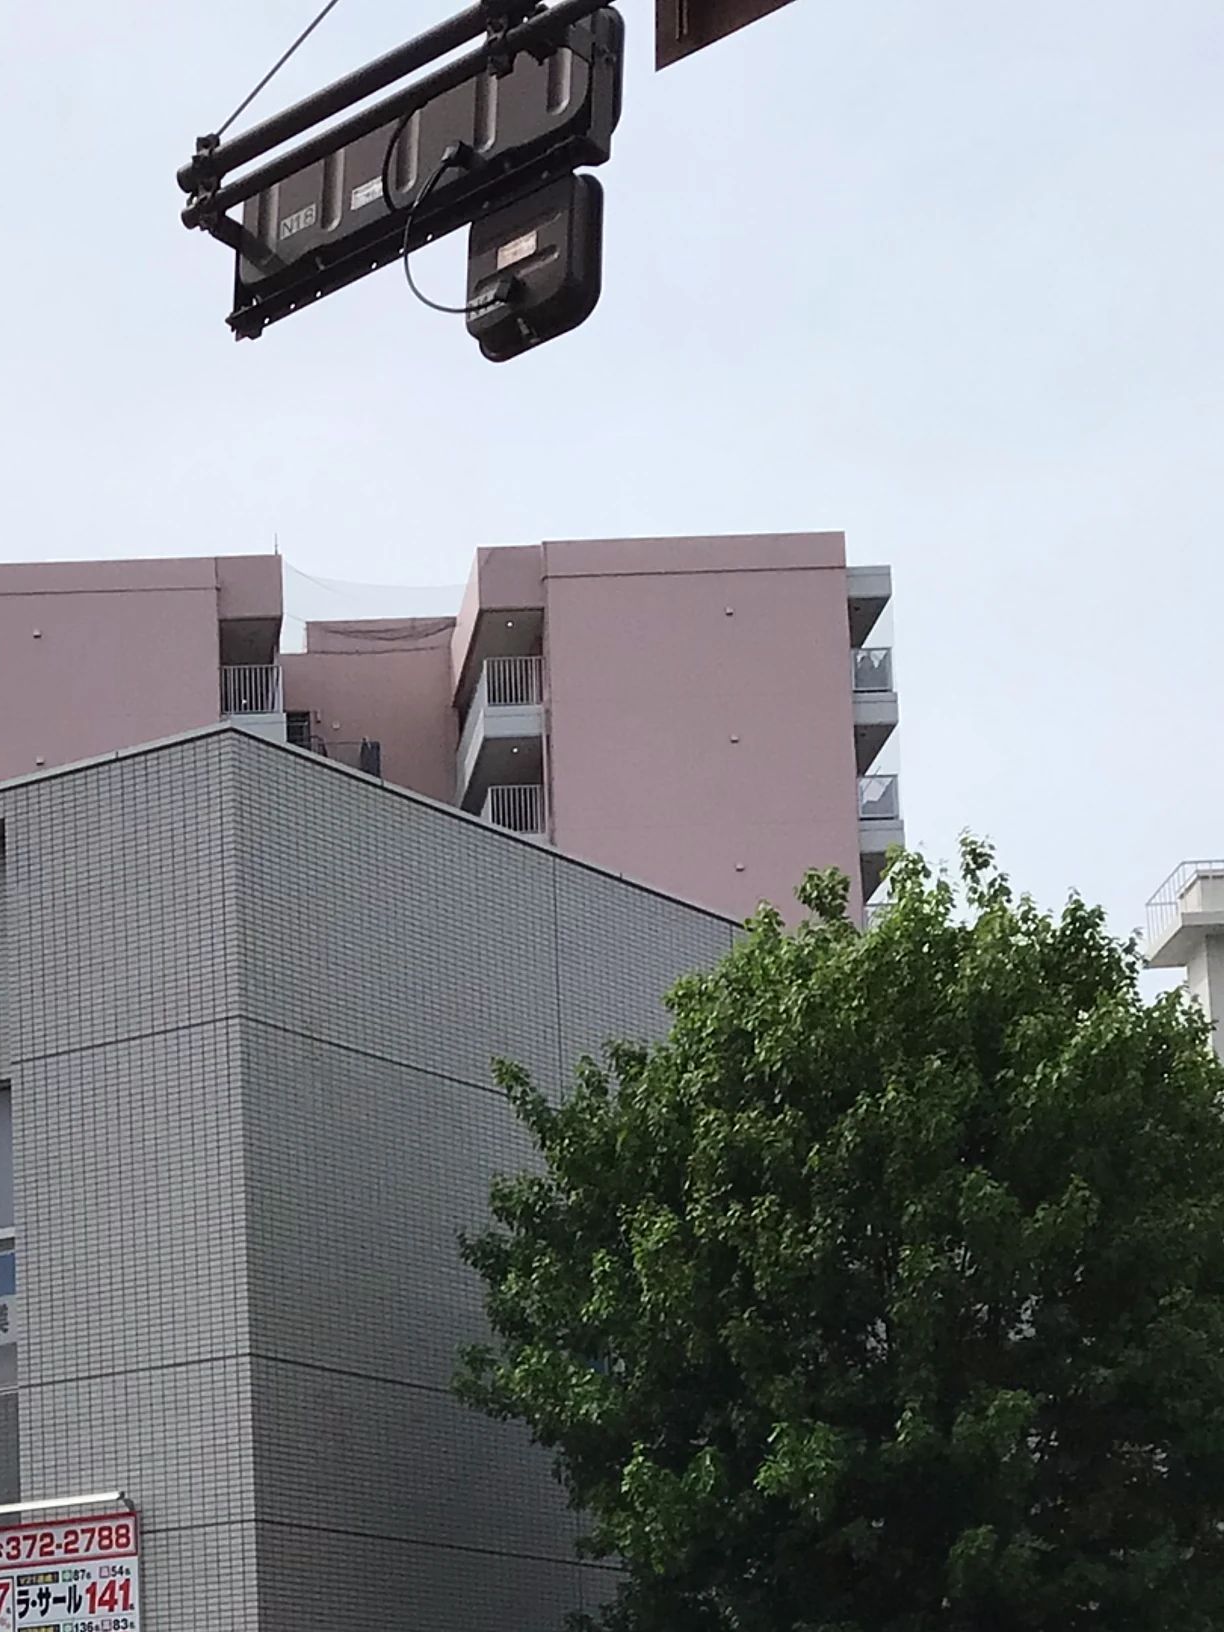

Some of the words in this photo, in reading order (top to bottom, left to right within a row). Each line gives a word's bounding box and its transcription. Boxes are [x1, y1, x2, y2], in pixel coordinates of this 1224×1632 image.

[282, 206, 316, 235] N18
[6, 1524, 131, 1561] 372-2788
[16, 1584, 83, 1619] ラ・サール
[85, 1577, 131, 1615] 141
